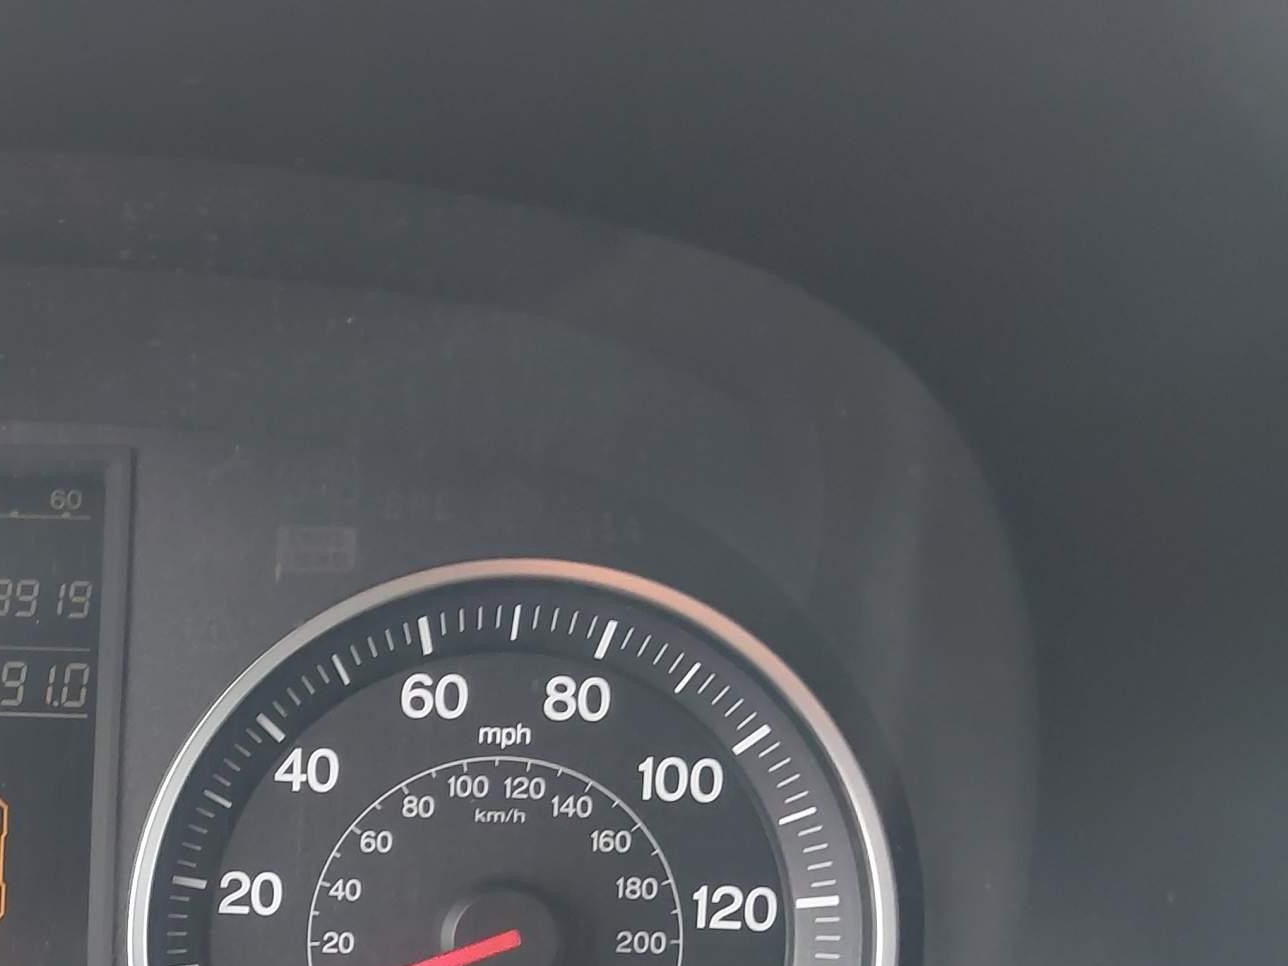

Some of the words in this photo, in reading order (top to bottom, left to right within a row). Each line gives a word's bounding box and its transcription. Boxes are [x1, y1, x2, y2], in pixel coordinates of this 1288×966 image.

[49, 489, 83, 511] 60
[400, 673, 469, 719] 60
[543, 676, 611, 722] 80
[478, 723, 532, 748] mph
[274, 747, 339, 793] 40
[638, 756, 723, 803] 100
[447, 775, 489, 798] 100
[504, 776, 546, 799] 120
[402, 795, 435, 819] 80
[474, 806, 526, 825] km/h
[551, 795, 593, 819] 140
[360, 830, 394, 854] 60
[590, 830, 632, 854] 160
[218, 871, 283, 916] 20
[329, 878, 362, 902] 40
[616, 877, 658, 901] 180
[692, 885, 777, 931] 120
[322, 932, 355, 955] 20
[616, 931, 667, 955] 200
